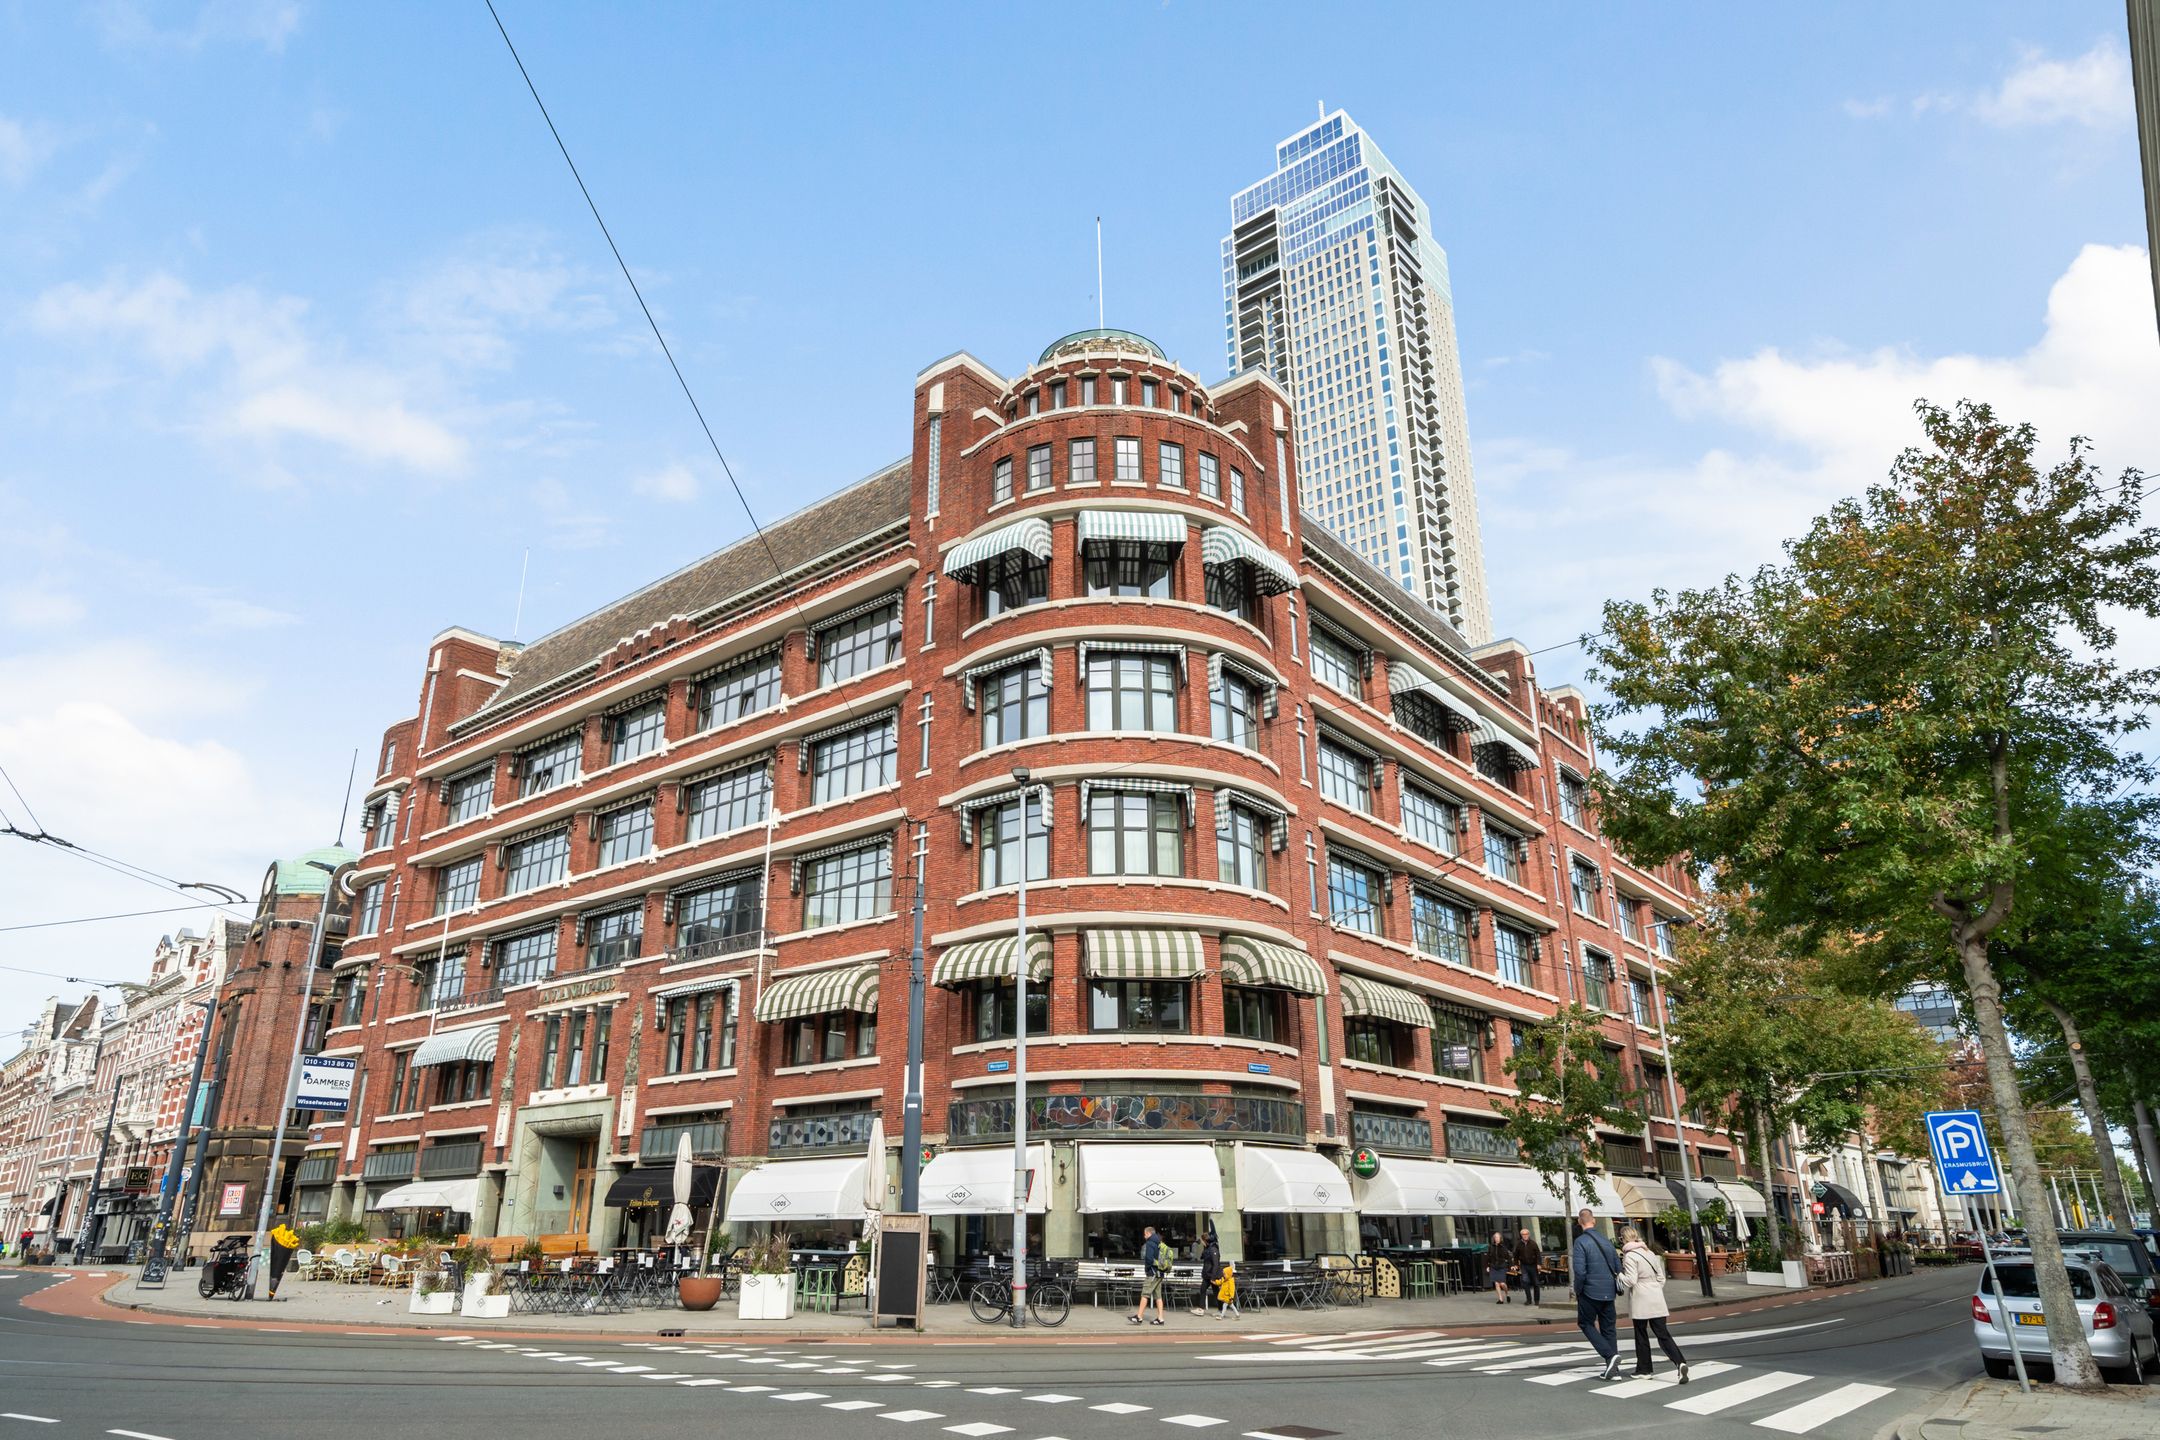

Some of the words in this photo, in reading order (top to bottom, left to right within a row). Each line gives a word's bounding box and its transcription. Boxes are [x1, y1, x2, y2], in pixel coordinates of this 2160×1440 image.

[306, 1077, 351, 1088] DAMMERS
[297, 1098, 342, 1107] Wisselwachter
[1946, 1131, 1971, 1159] P
